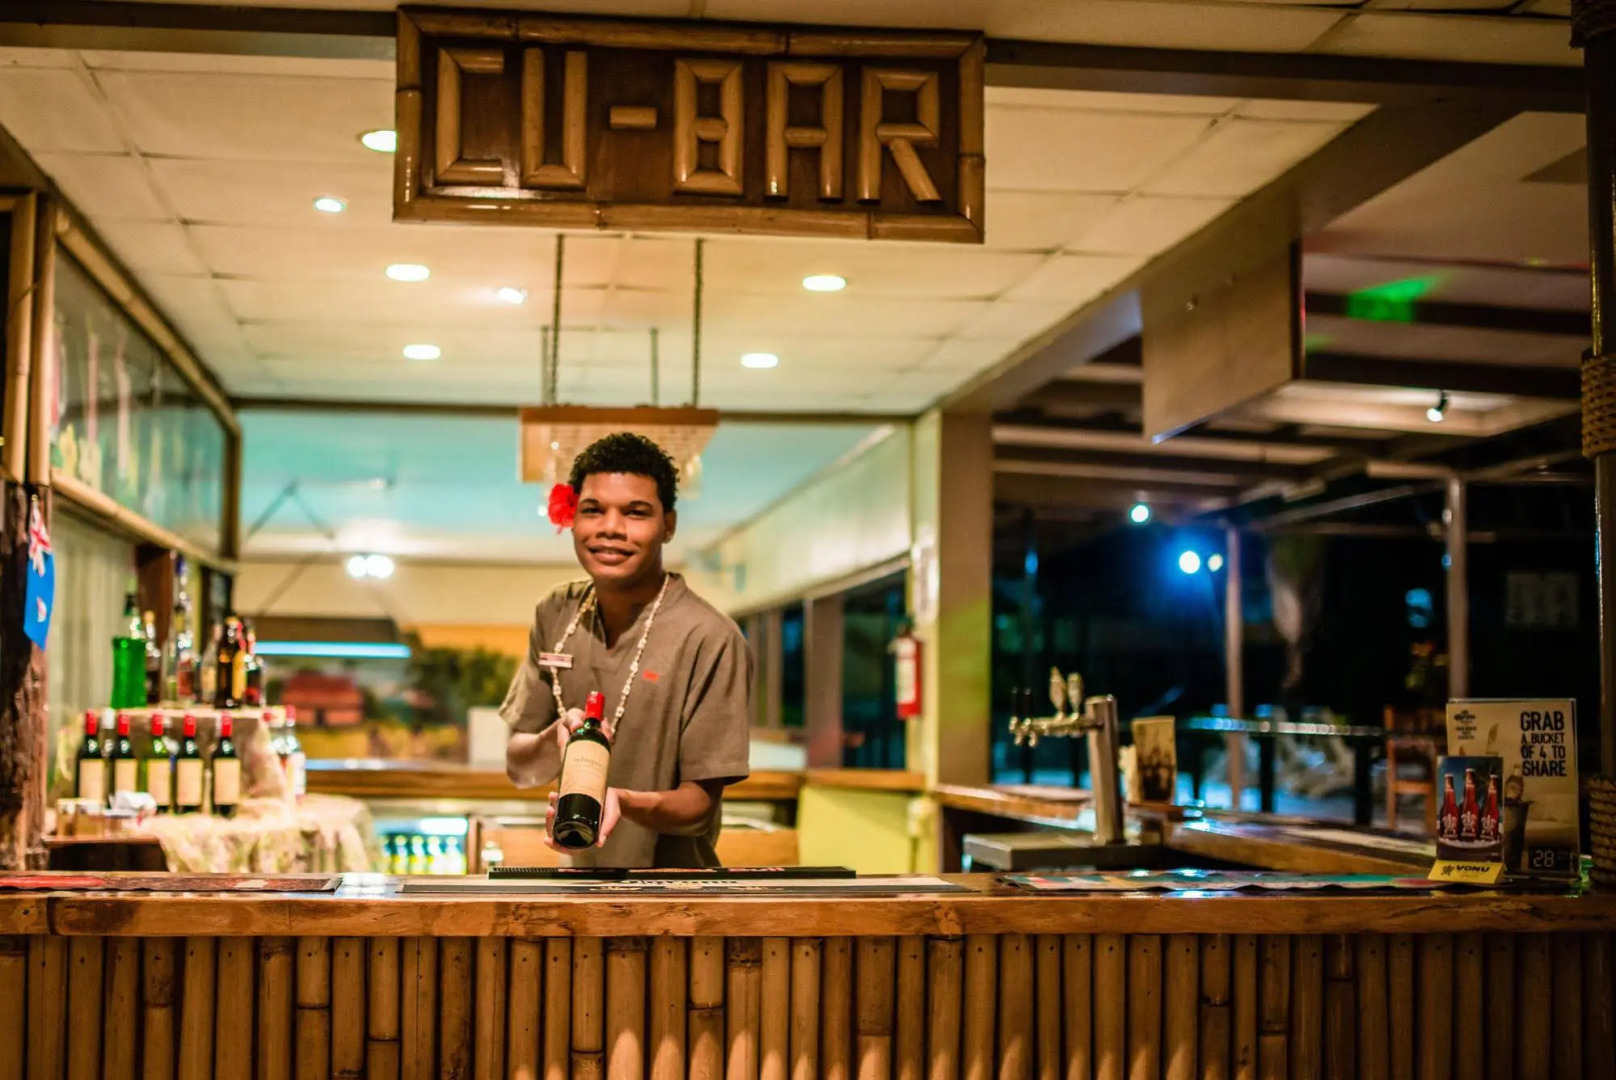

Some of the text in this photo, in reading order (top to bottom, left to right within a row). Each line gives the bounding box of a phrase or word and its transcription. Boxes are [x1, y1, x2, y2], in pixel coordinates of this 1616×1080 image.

[434, 45, 942, 202] CU-BAR
[1520, 711, 1564, 732] GRAB
[1521, 732, 1565, 745] A BUCKET
[1520, 745, 1566, 760] OF 4 TO
[1522, 760, 1567, 777] SHARE
[1456, 864, 1490, 873] VONU
